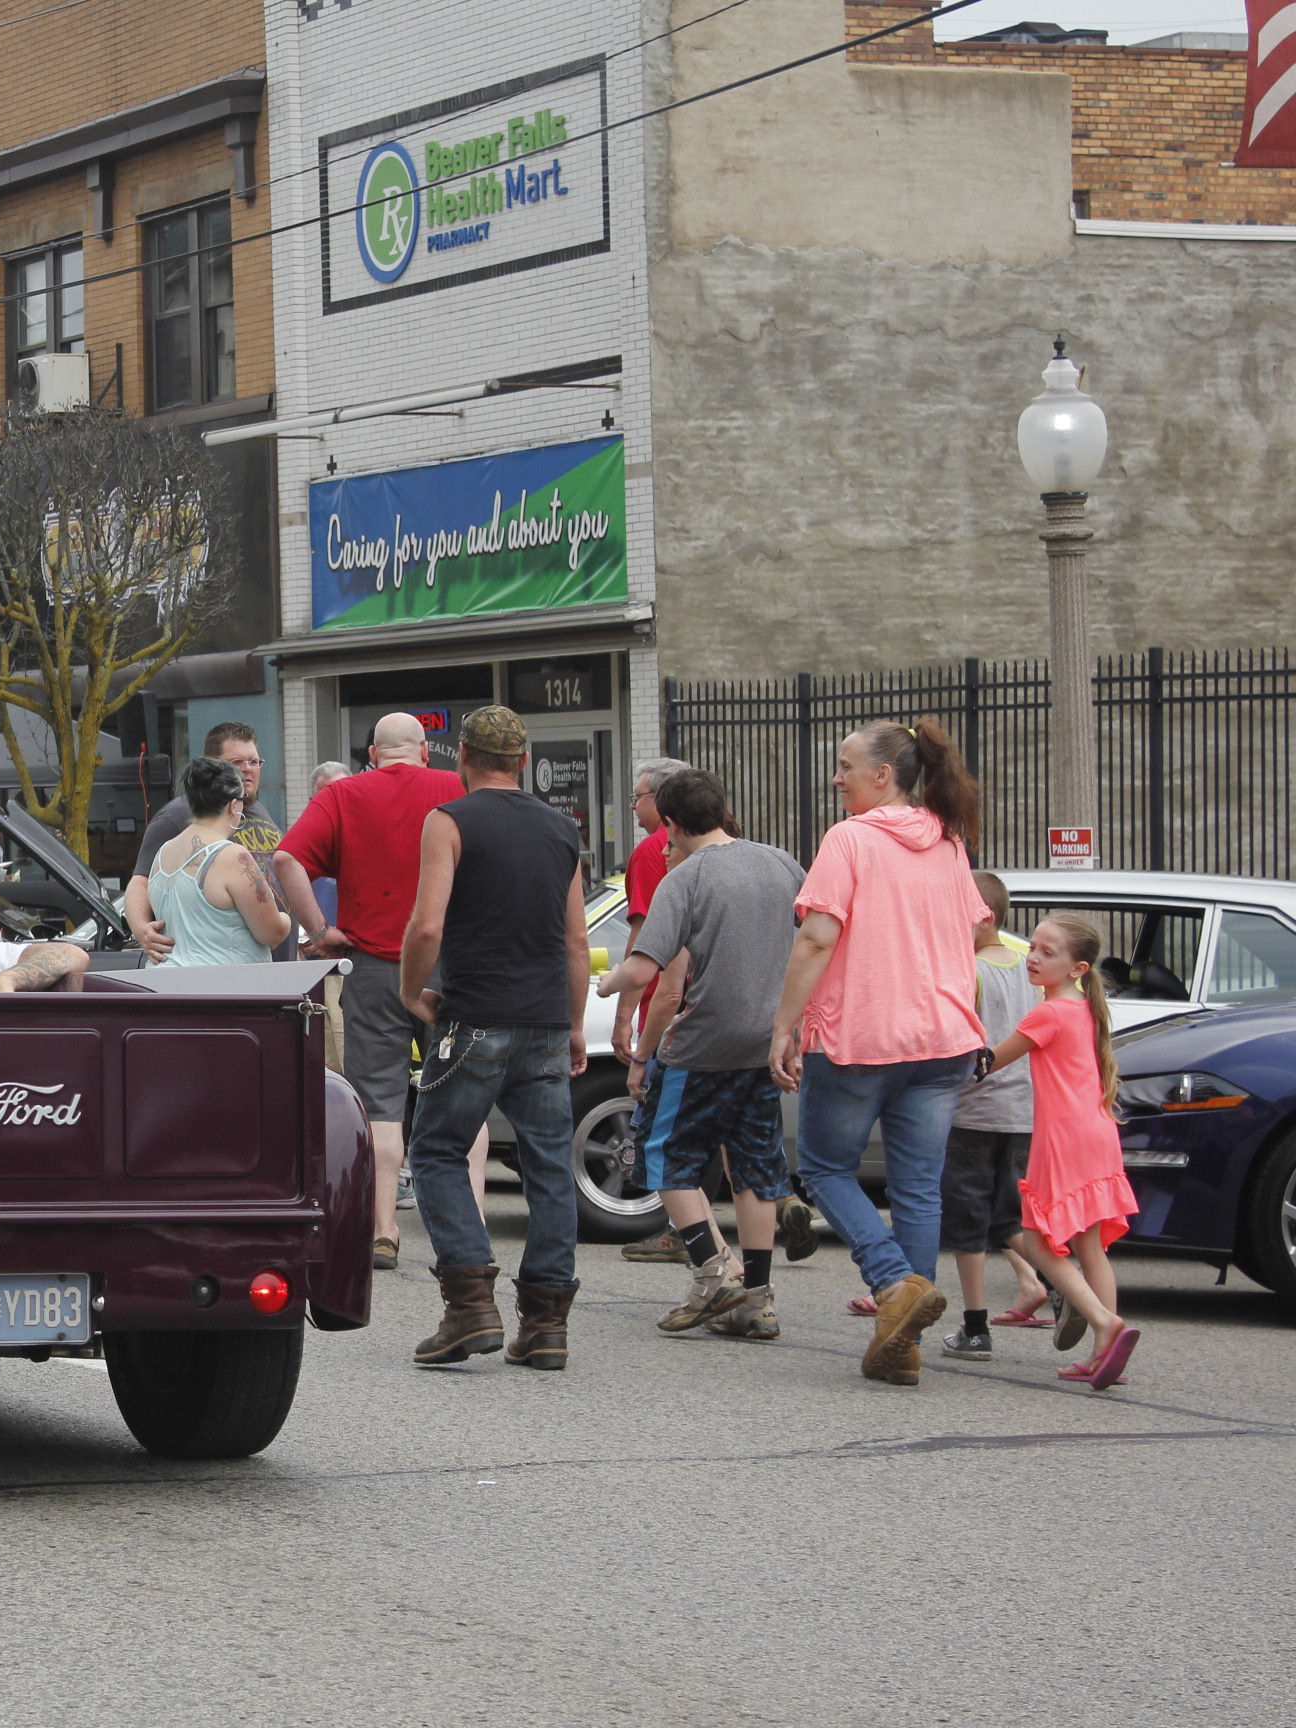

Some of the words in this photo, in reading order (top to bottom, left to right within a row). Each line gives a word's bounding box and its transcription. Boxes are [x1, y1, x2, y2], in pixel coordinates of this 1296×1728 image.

[424, 131, 504, 183] Beaver
[507, 108, 567, 158] Falls
[427, 222, 491, 253] PHARMACY
[327, 513, 390, 591] Caring
[394, 514, 423, 588] for
[426, 529, 463, 586] you
[467, 490, 505, 555] and
[508, 488, 563, 549] about
[568, 509, 610, 570] you
[545, 678, 582, 707] 1314
[428, 741, 461, 761] EALTH
[552, 761, 572, 772] Beaver
[572, 760, 586, 771] Falls
[1052, 843, 1090, 855] PARKING
[1061, 830, 1079, 842] NO
[4, 1286, 82, 1328] YD83
